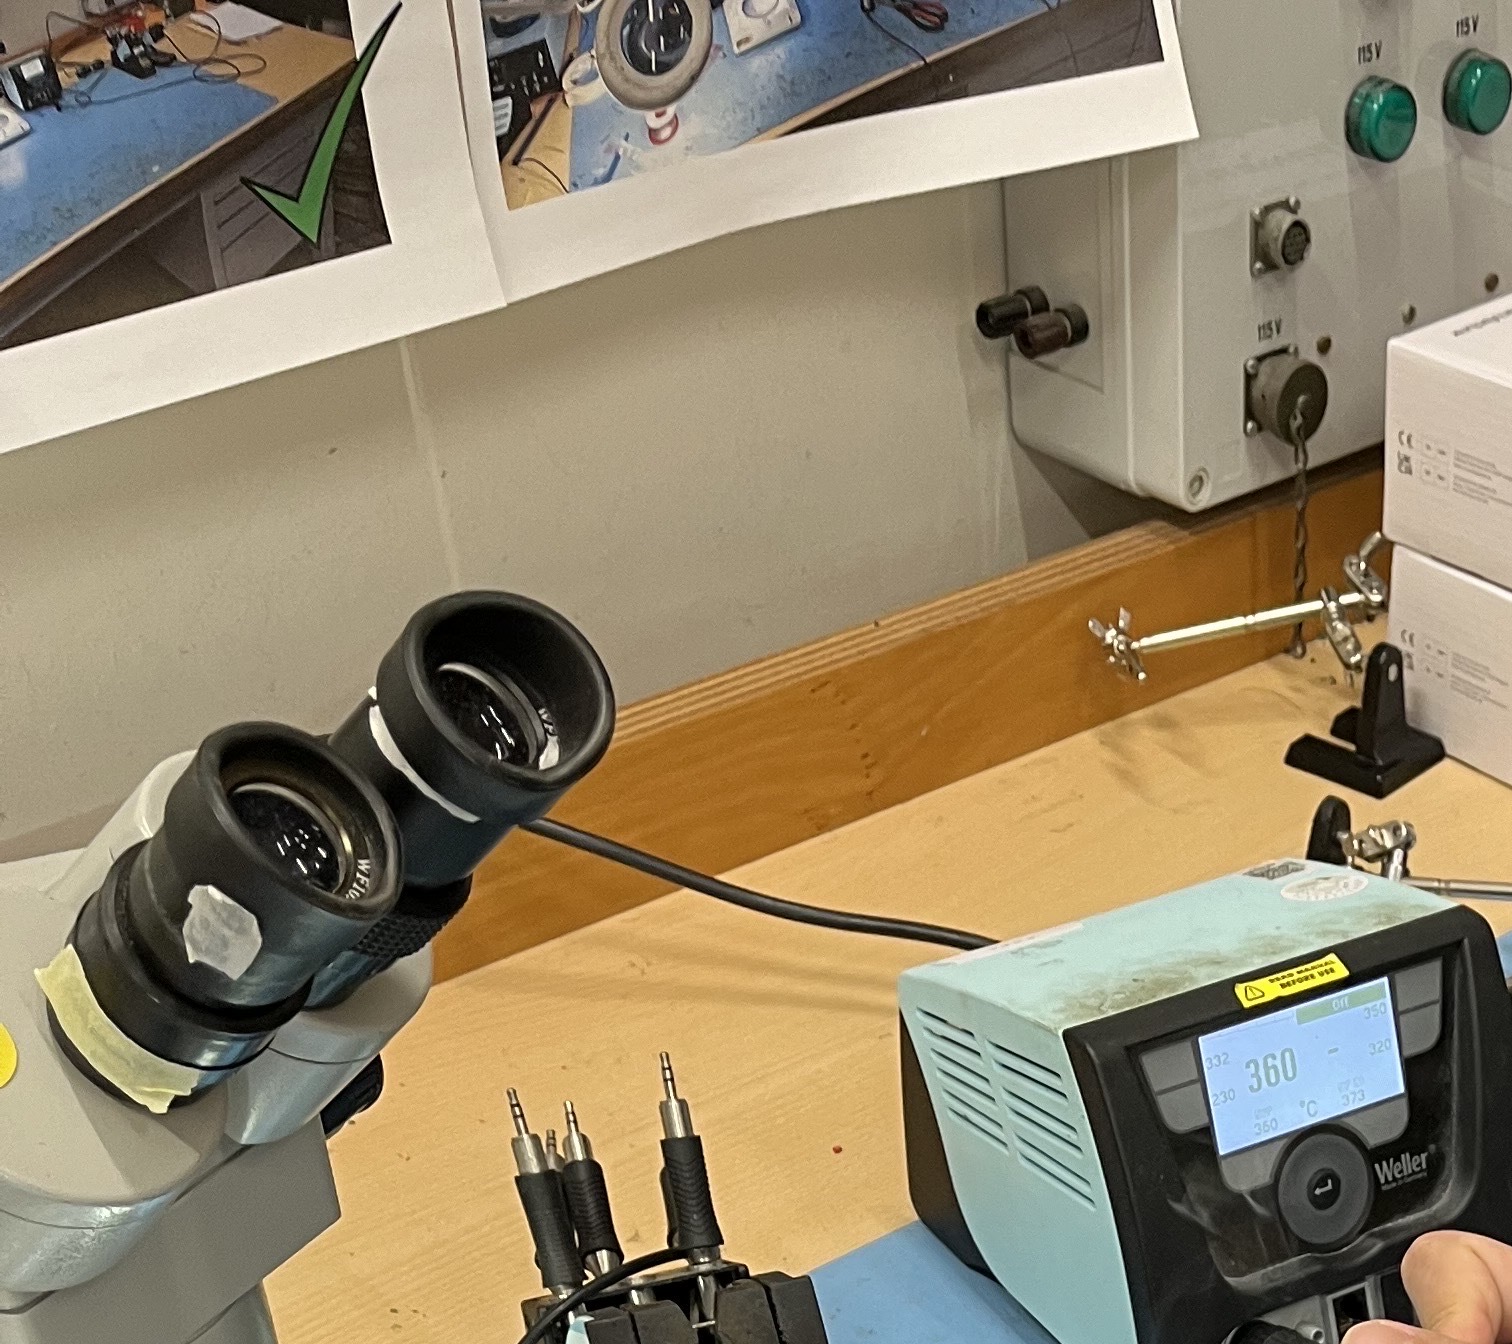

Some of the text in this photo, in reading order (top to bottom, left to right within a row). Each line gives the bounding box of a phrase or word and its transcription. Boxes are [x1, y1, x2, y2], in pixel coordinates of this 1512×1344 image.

[1364, 1002, 1388, 1020] 350
[1368, 1038, 1392, 1056] 320
[1206, 1052, 1230, 1071] 332
[1245, 1047, 1298, 1094] 360
[1212, 1088, 1236, 1107] 230
[1374, 1152, 1428, 1184] Weller
